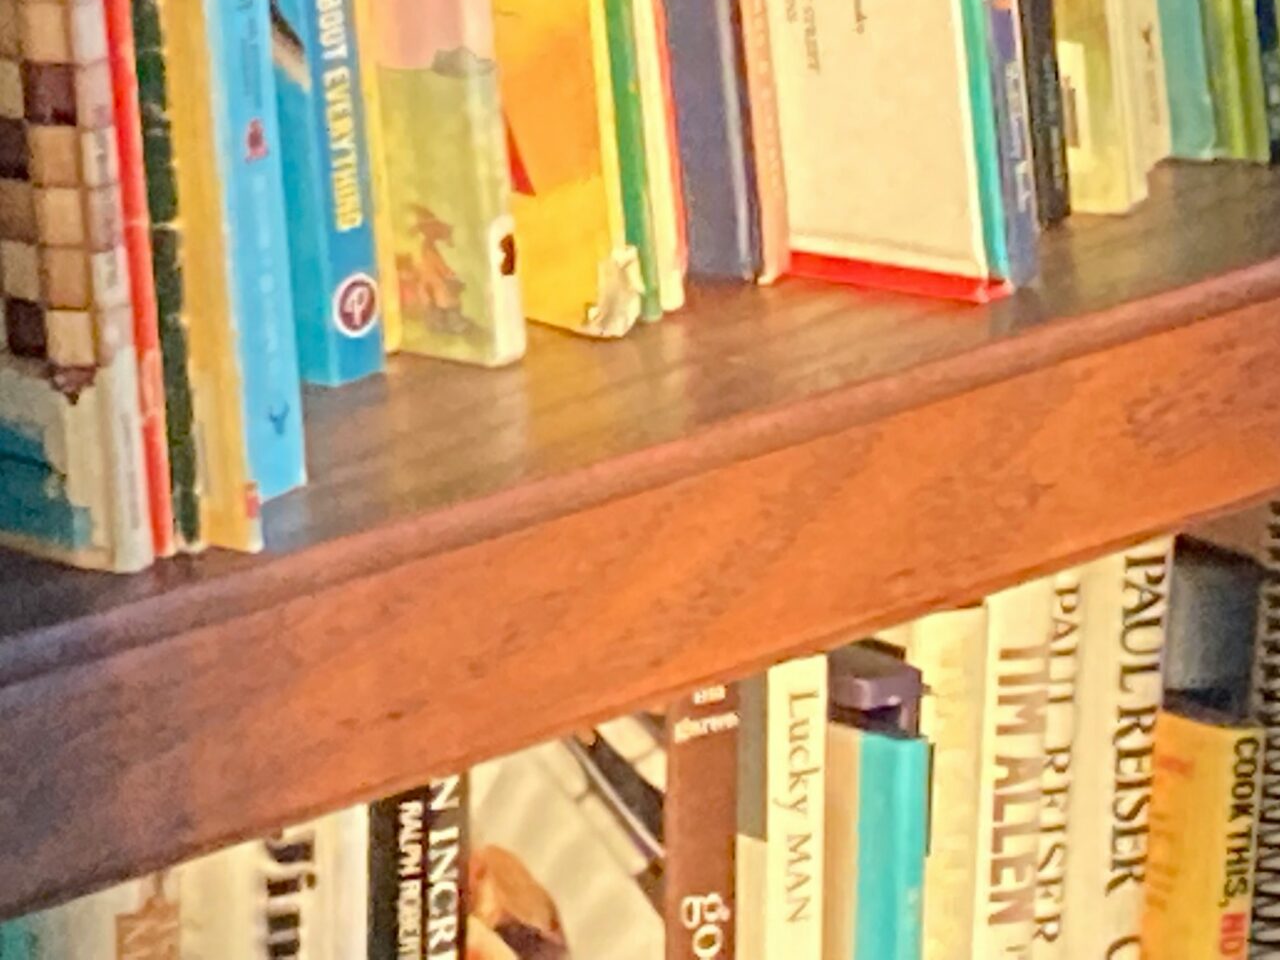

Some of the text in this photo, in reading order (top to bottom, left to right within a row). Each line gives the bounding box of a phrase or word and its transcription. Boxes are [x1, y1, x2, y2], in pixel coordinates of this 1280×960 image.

[321, 65, 364, 232] EVERYTHING
[1119, 554, 1165, 694] PAUL
[773, 690, 820, 923] Lucky MAN
[988, 754, 1045, 926] ALLEN
[1033, 745, 1070, 942] REISER
[1105, 704, 1158, 897] REISER
[1227, 737, 1260, 822] COOK
[1218, 825, 1253, 908] THIS,
